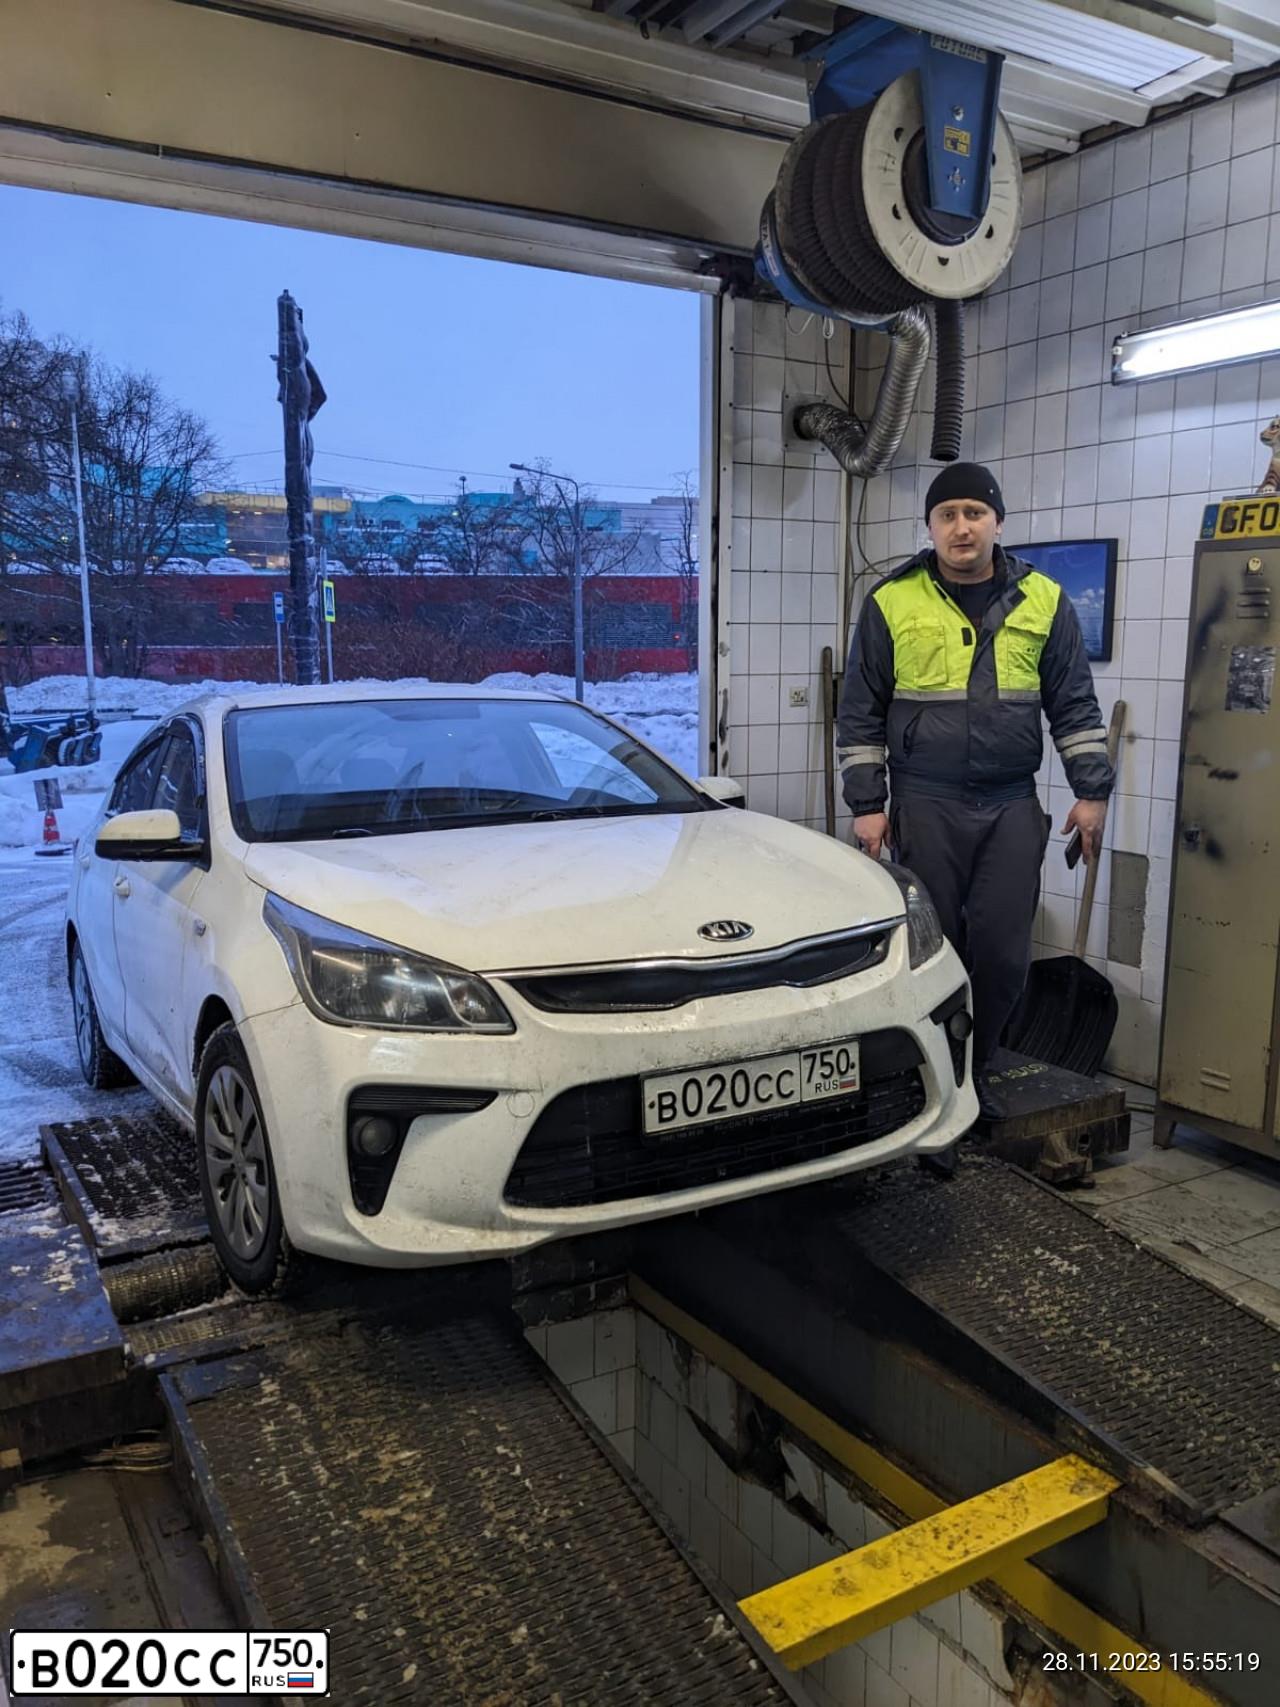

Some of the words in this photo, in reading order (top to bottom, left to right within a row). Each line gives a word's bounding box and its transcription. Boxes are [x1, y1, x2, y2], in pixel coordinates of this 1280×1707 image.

[702, 921, 751, 939] KIA
[802, 1048, 850, 1084] 750
[814, 1079, 839, 1094] RUS
